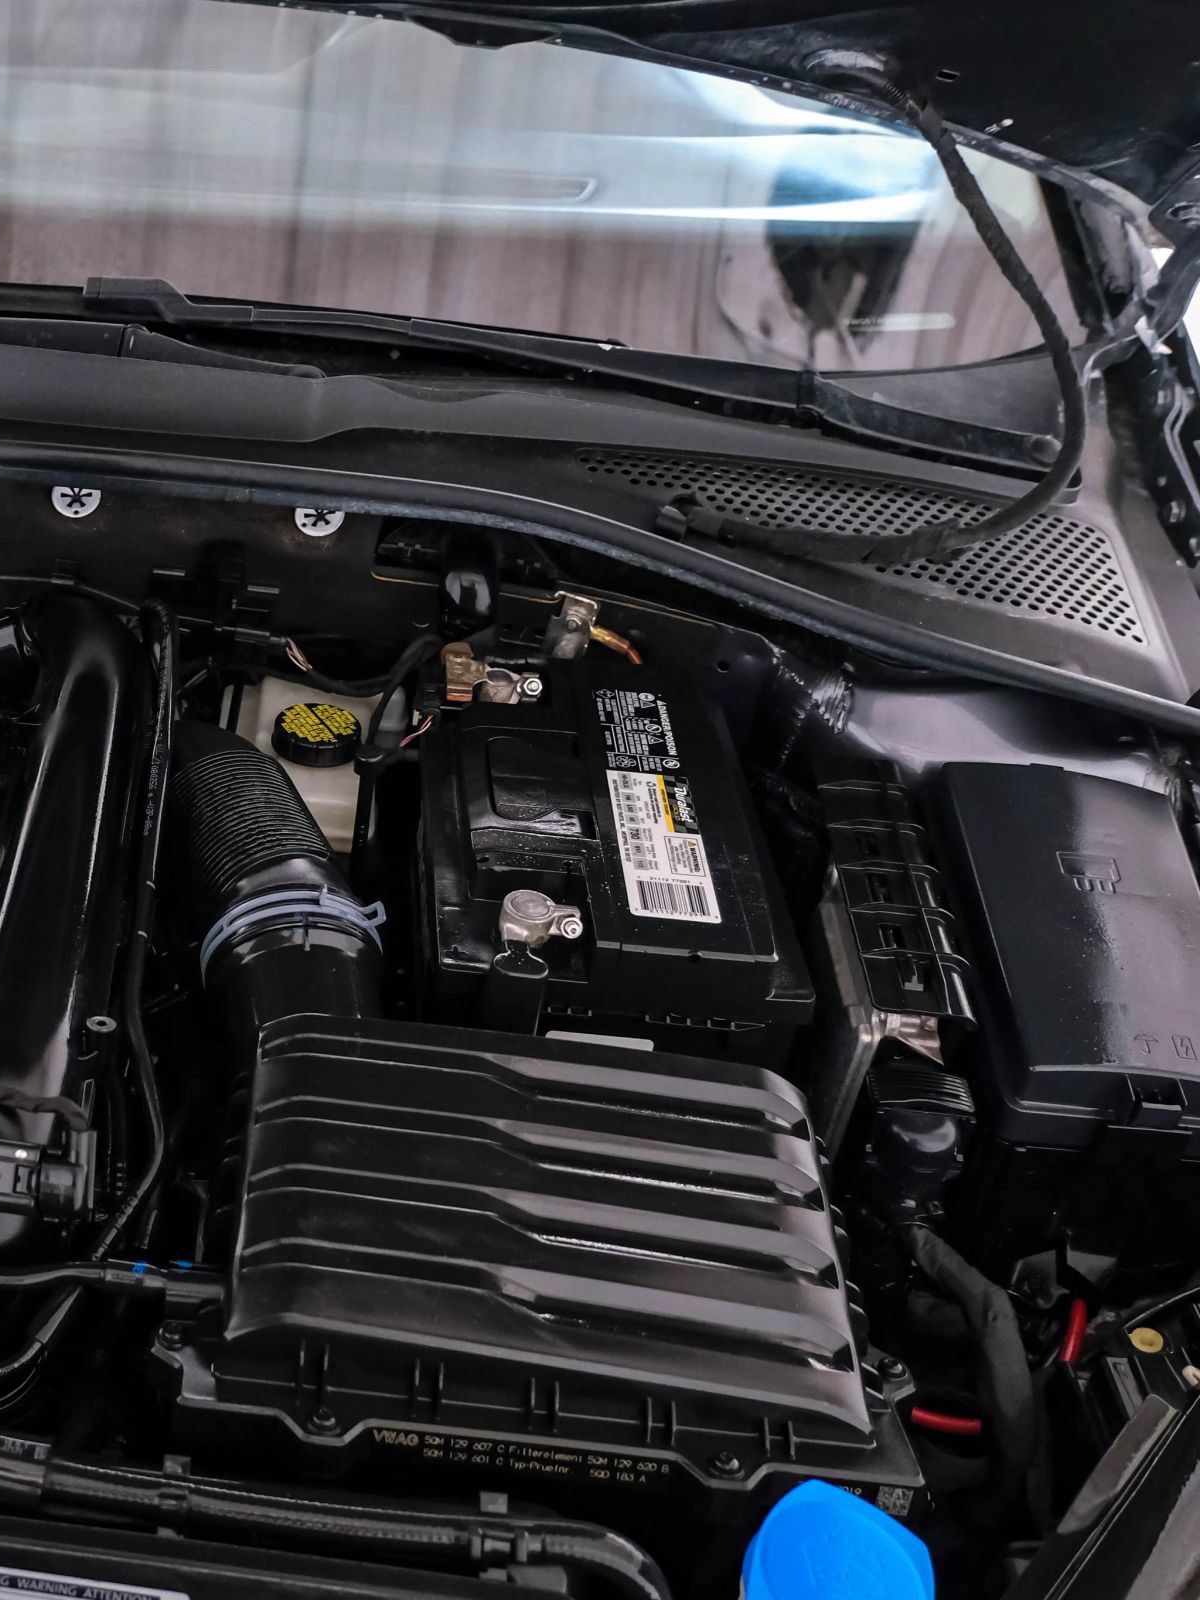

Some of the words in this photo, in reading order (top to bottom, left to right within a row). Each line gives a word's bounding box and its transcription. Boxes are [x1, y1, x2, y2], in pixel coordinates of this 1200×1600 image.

[674, 786, 694, 823] Duralast
[629, 827, 640, 840] 730
[373, 1429, 419, 1446] VWAG
[450, 1438, 468, 1448] 129
[472, 1442, 492, 1452] 607
[497, 1444, 505, 1453] C
[508, 1445, 583, 1462] Filterelement
[614, 1458, 632, 1469] 129
[636, 1462, 657, 1471] 620
[450, 1451, 468, 1460] 129
[471, 1454, 489, 1464] 601
[496, 1457, 503, 1465] C
[616, 1472, 634, 1481] 183
[16, 1578, 78, 1597] WARNING
